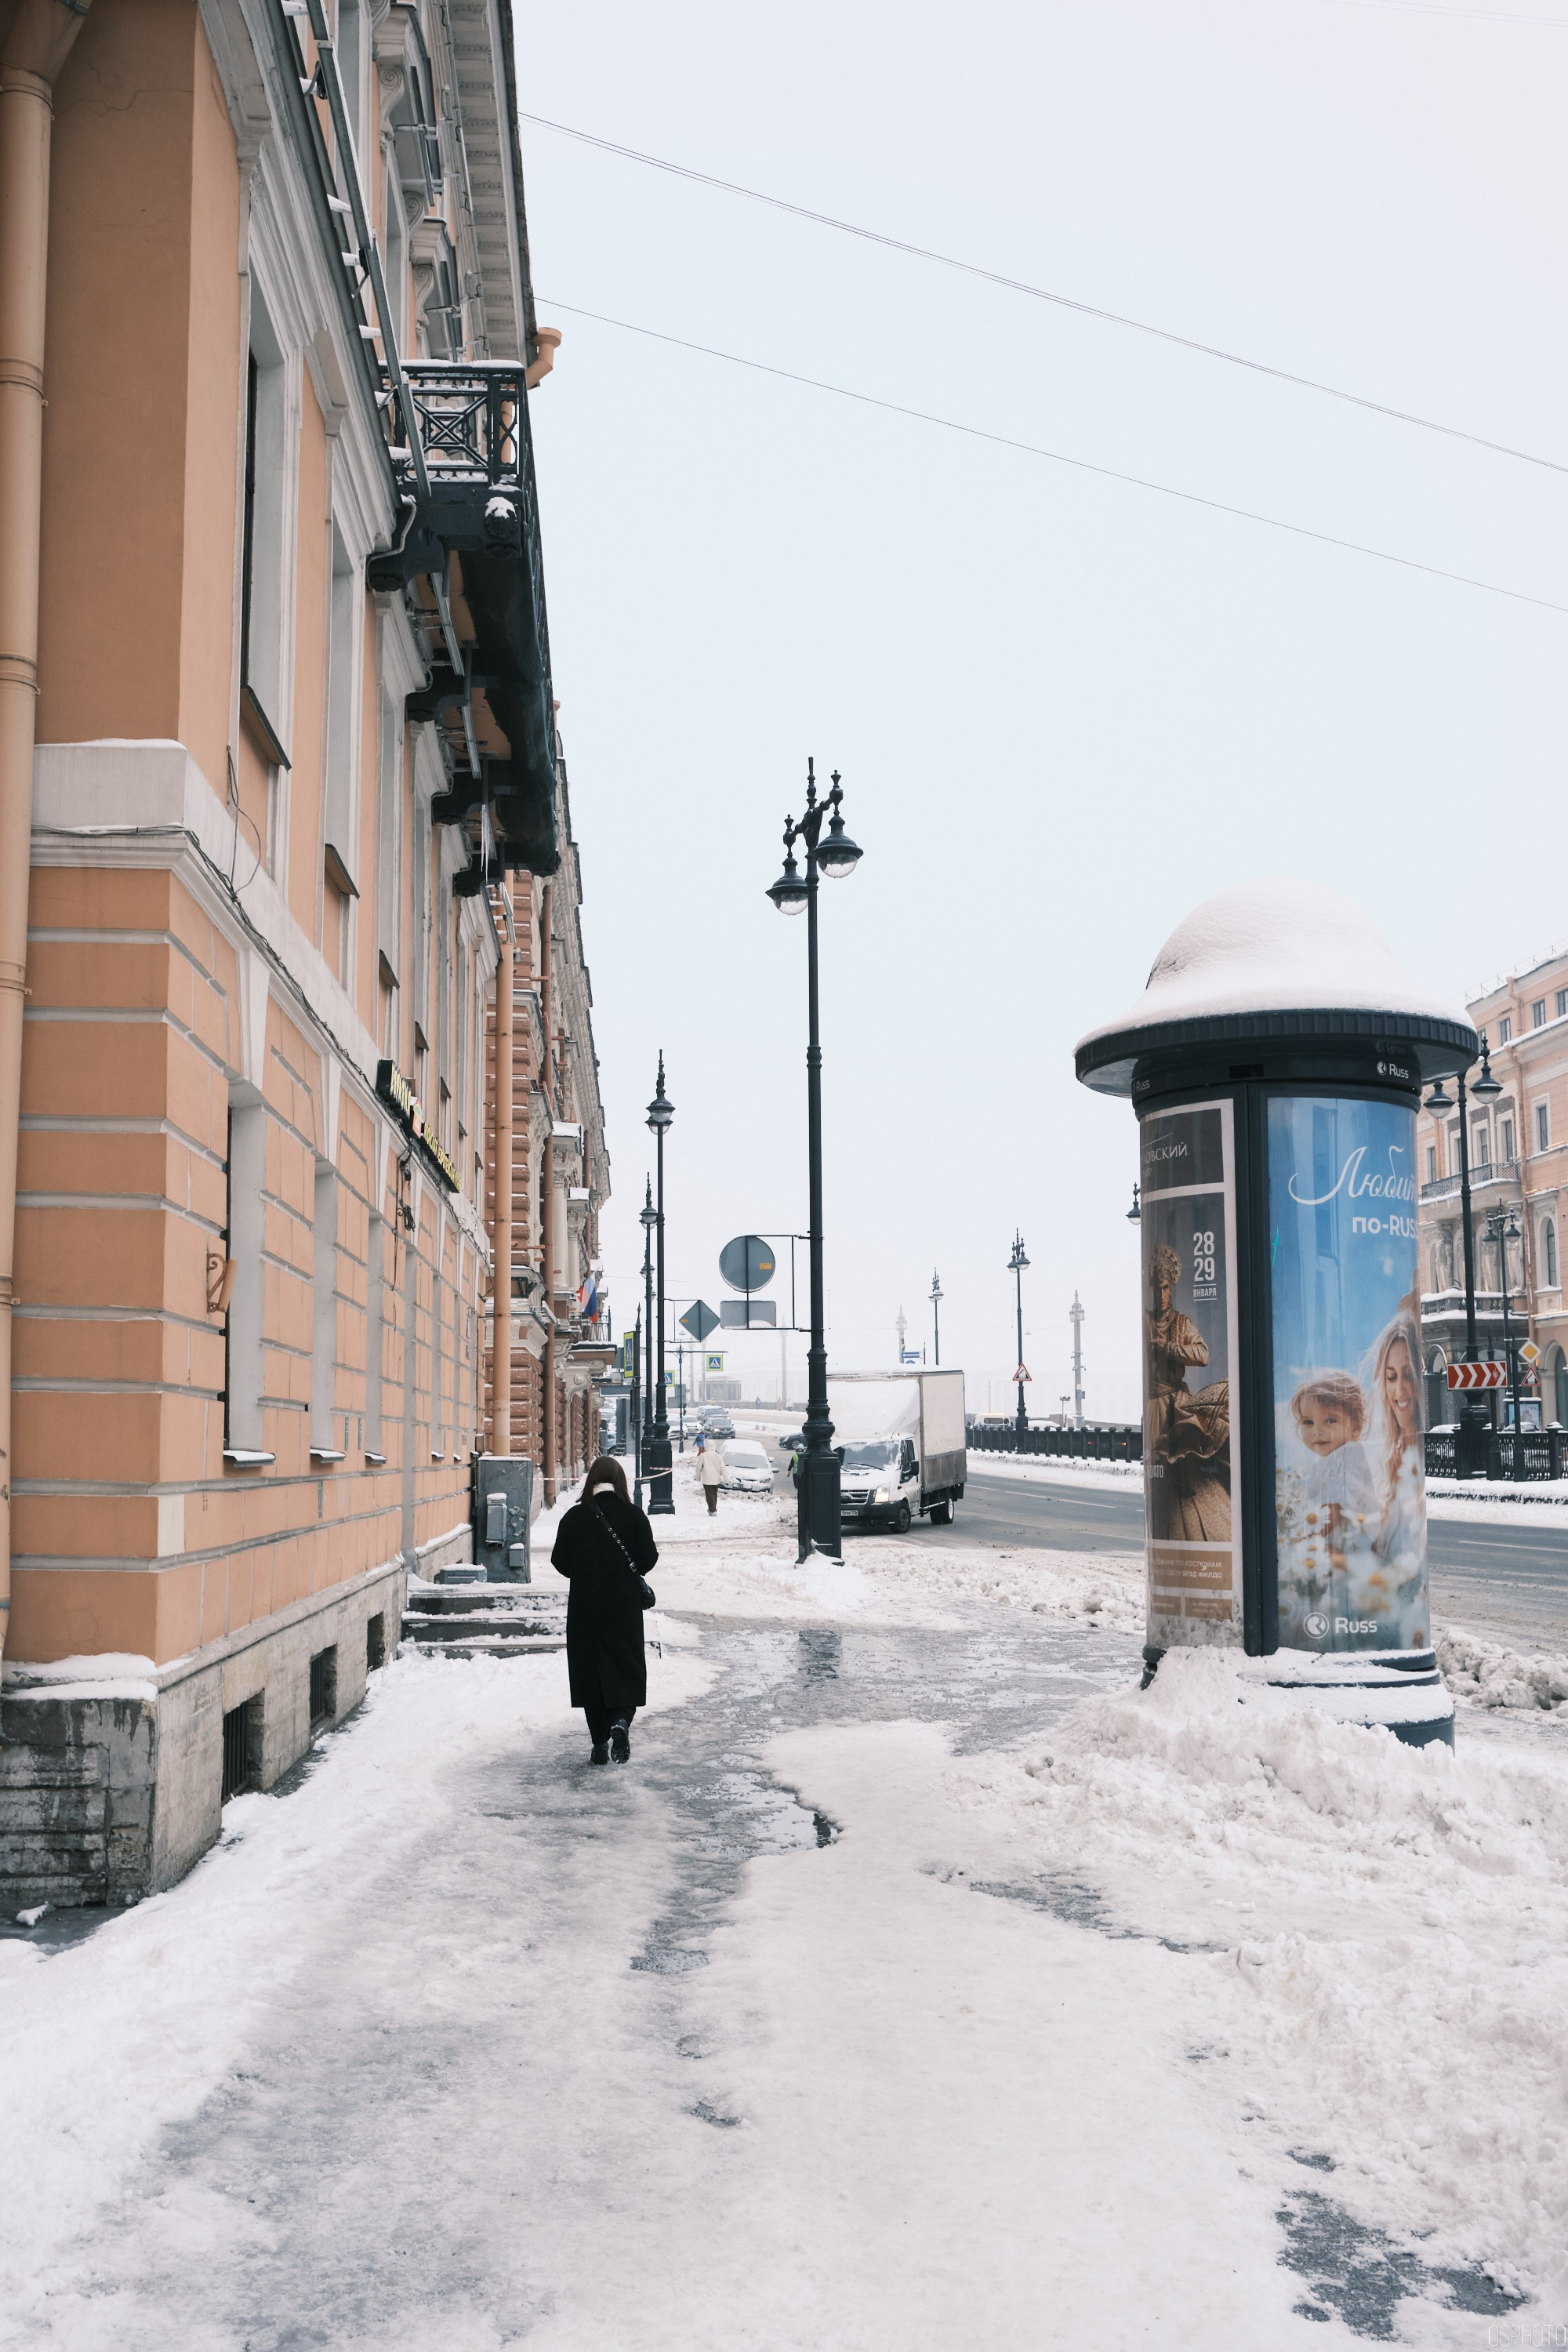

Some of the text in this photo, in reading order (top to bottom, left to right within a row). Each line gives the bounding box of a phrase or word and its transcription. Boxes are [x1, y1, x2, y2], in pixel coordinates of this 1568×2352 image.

[1145, 1142, 1188, 1163] ОВСКИЙ
[1193, 1231, 1214, 1256] 28
[1194, 1257, 1215, 1282] 29
[1193, 1287, 1217, 1298] ЯНВАРЯ
[1198, 1571, 1223, 1580] ФИЛДС
